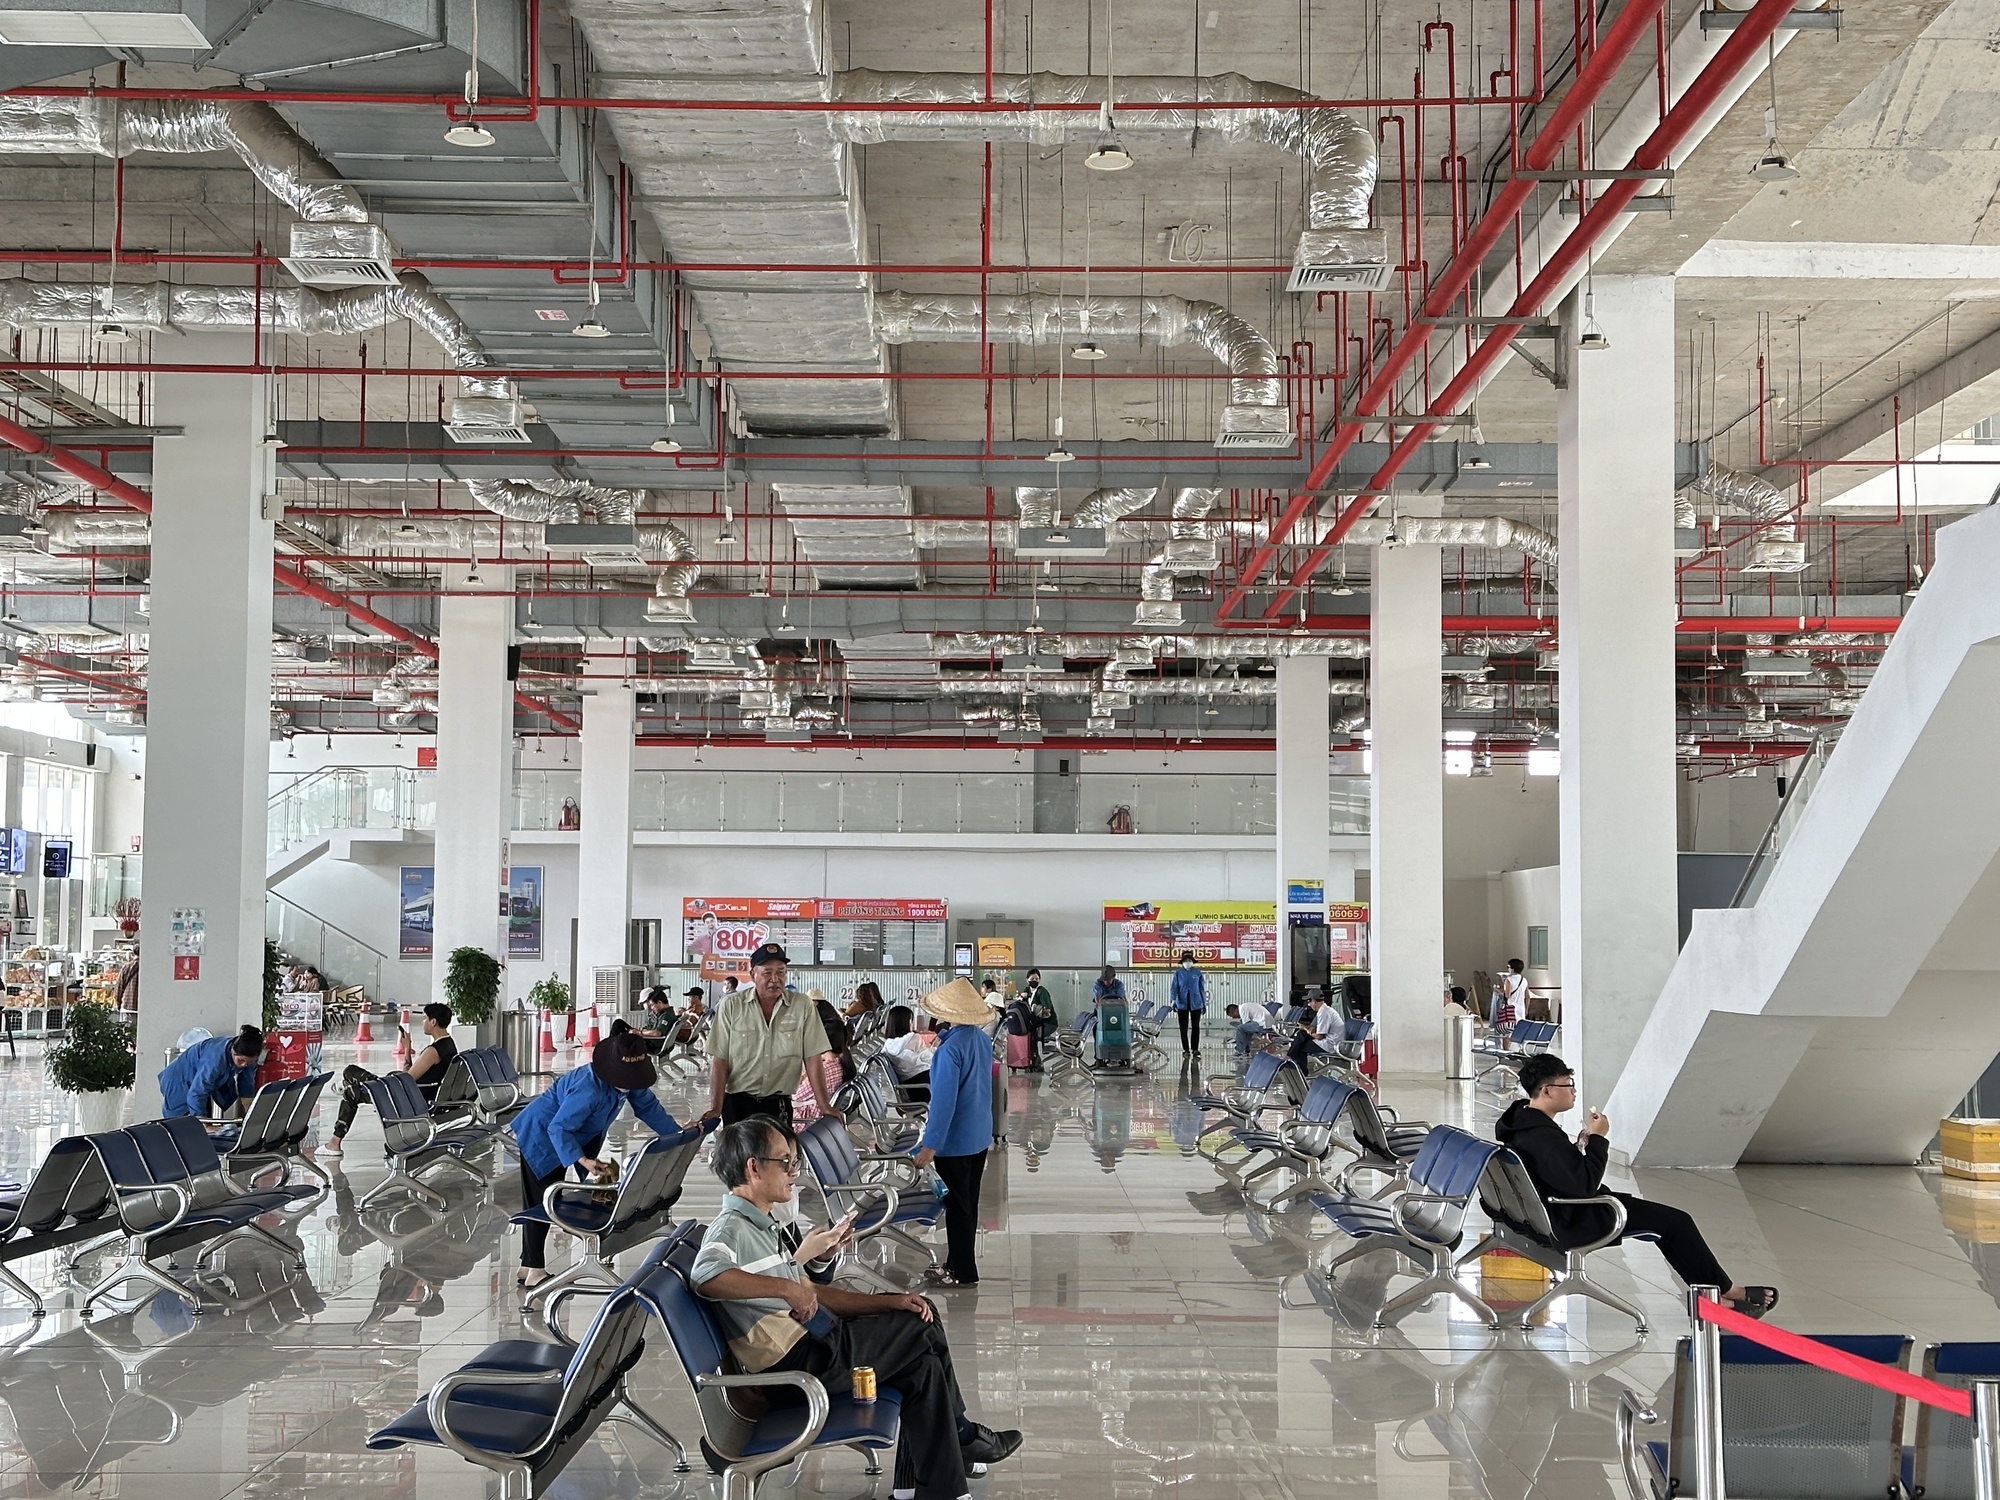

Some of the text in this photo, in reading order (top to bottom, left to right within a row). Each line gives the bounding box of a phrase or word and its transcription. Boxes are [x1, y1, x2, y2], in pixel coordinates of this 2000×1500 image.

[839, 905, 904, 917] PHƯƠNG TRANG
[907, 909, 925, 917] 1900
[1263, 924, 1278, 934] TRA
[717, 929, 763, 951] 80k
[841, 987, 853, 1000] 22
[907, 988, 919, 1000] 21
[1131, 989, 1145, 1002] 20
